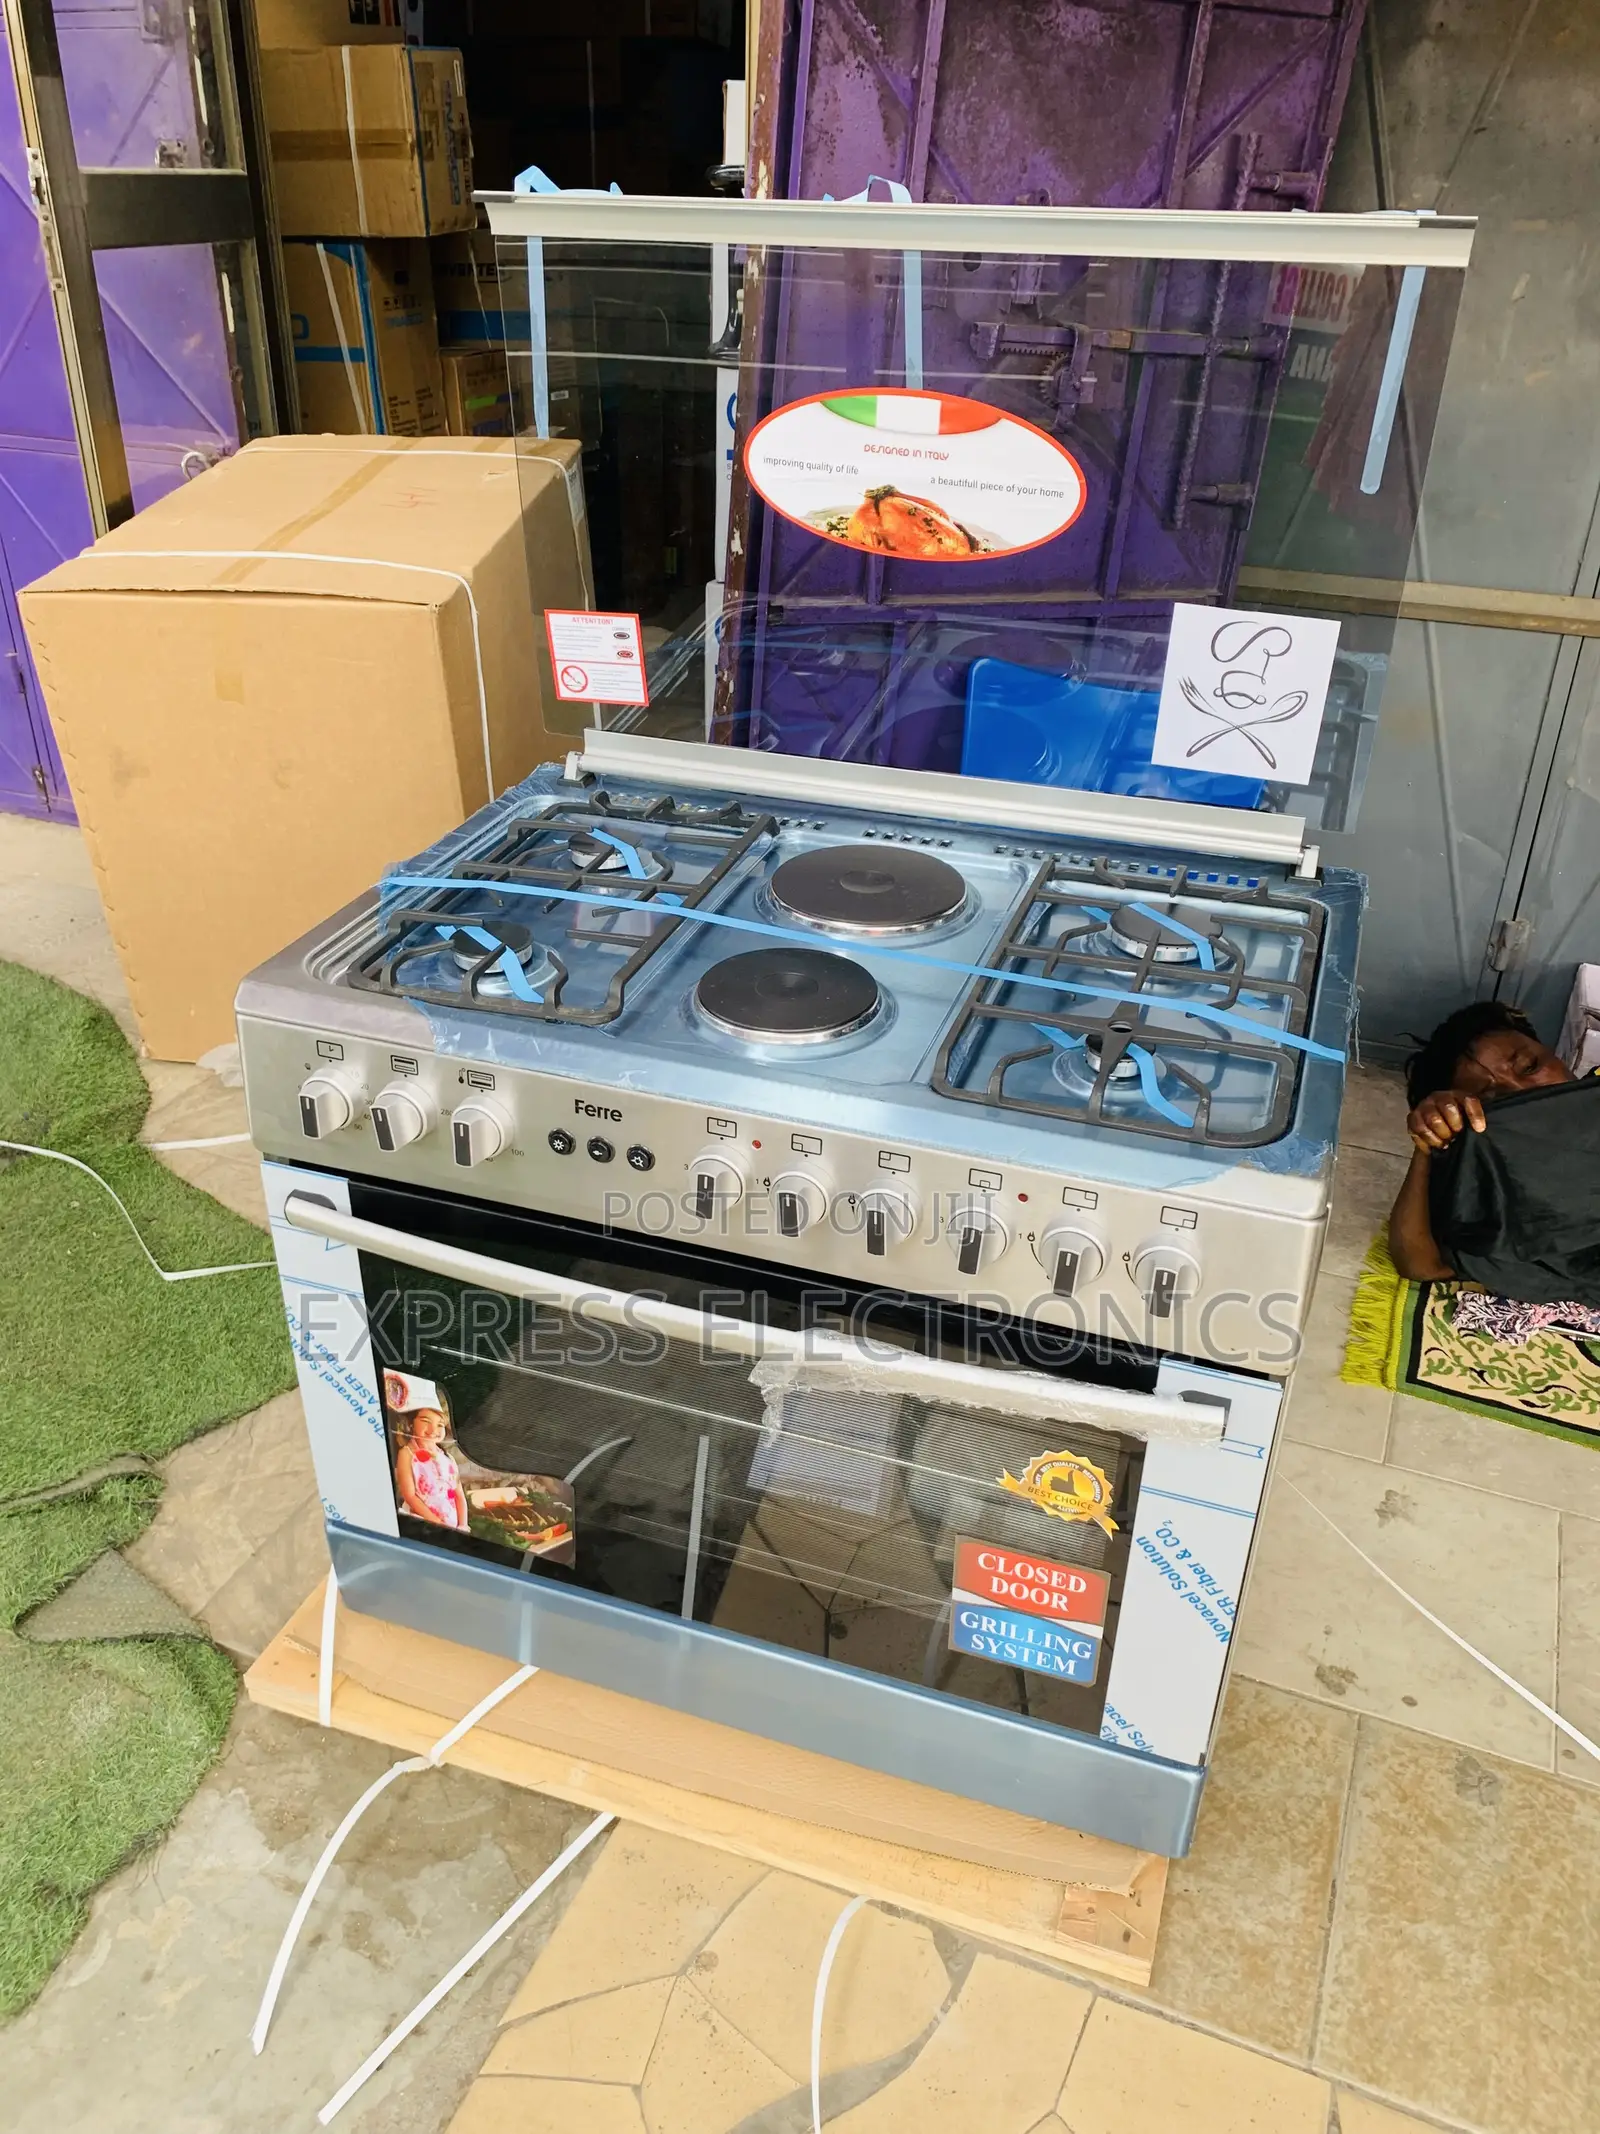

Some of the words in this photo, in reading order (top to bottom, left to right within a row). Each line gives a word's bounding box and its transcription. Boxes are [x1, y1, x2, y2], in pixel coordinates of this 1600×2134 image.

[763, 455, 805, 470] improving
[806, 459, 834, 475] quality
[835, 461, 844, 472] of
[846, 463, 859, 475] life
[863, 443, 910, 458] DESIGNED
[912, 449, 923, 458] IN
[924, 449, 950, 461] ITALY
[930, 477, 936, 485] a
[938, 474, 979, 490] beautifull
[980, 480, 1004, 493] piece
[1006, 482, 1015, 493] of
[1017, 485, 1037, 498] your
[1039, 486, 1065, 499] home
[574, 1098, 623, 1123] Ferre
[319, 1371, 368, 1417] Novacel
[344, 1373, 381, 1412] ASER
[1027, 1486, 1053, 1499] BEST
[1054, 1494, 1095, 1511] CHOICE
[1136, 1536, 1188, 1591] Solution
[1175, 1548, 1192, 1560] &
[977, 1552, 1087, 1594] CLOSED
[1187, 1562, 1224, 1596] Fiber
[990, 1576, 1070, 1612] DOOR
[960, 1611, 1092, 1660] GRILLING
[1180, 1592, 1231, 1643] Novacel
[971, 1635, 1077, 1676] SYSTEM
